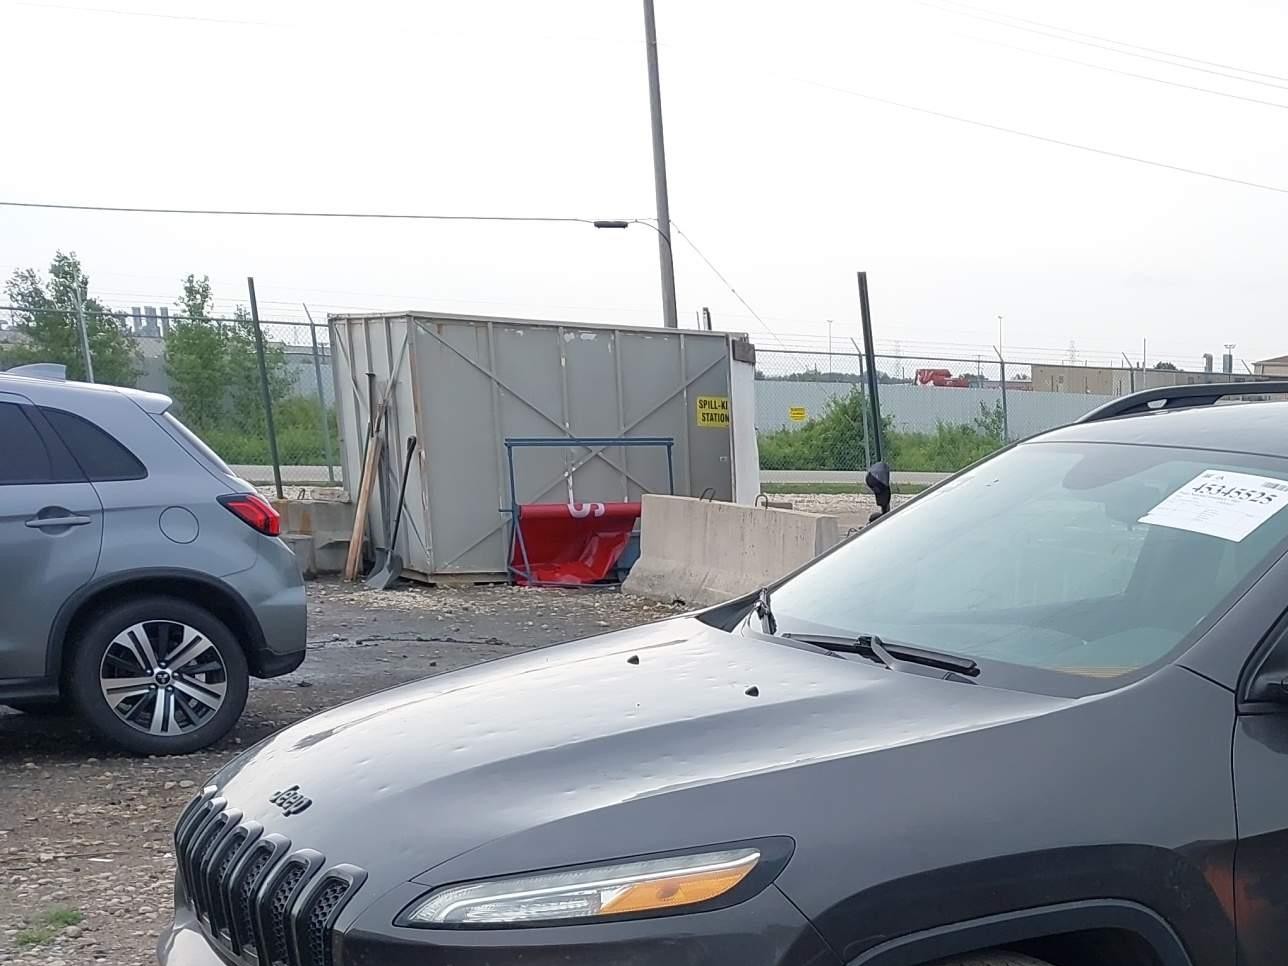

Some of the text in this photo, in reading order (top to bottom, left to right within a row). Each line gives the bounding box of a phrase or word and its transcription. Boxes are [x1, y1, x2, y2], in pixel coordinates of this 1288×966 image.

[698, 399, 728, 410] SPILL-KI
[701, 412, 730, 423] STATION
[1192, 482, 1278, 505] 45345525
[269, 784, 313, 817] Jeep
